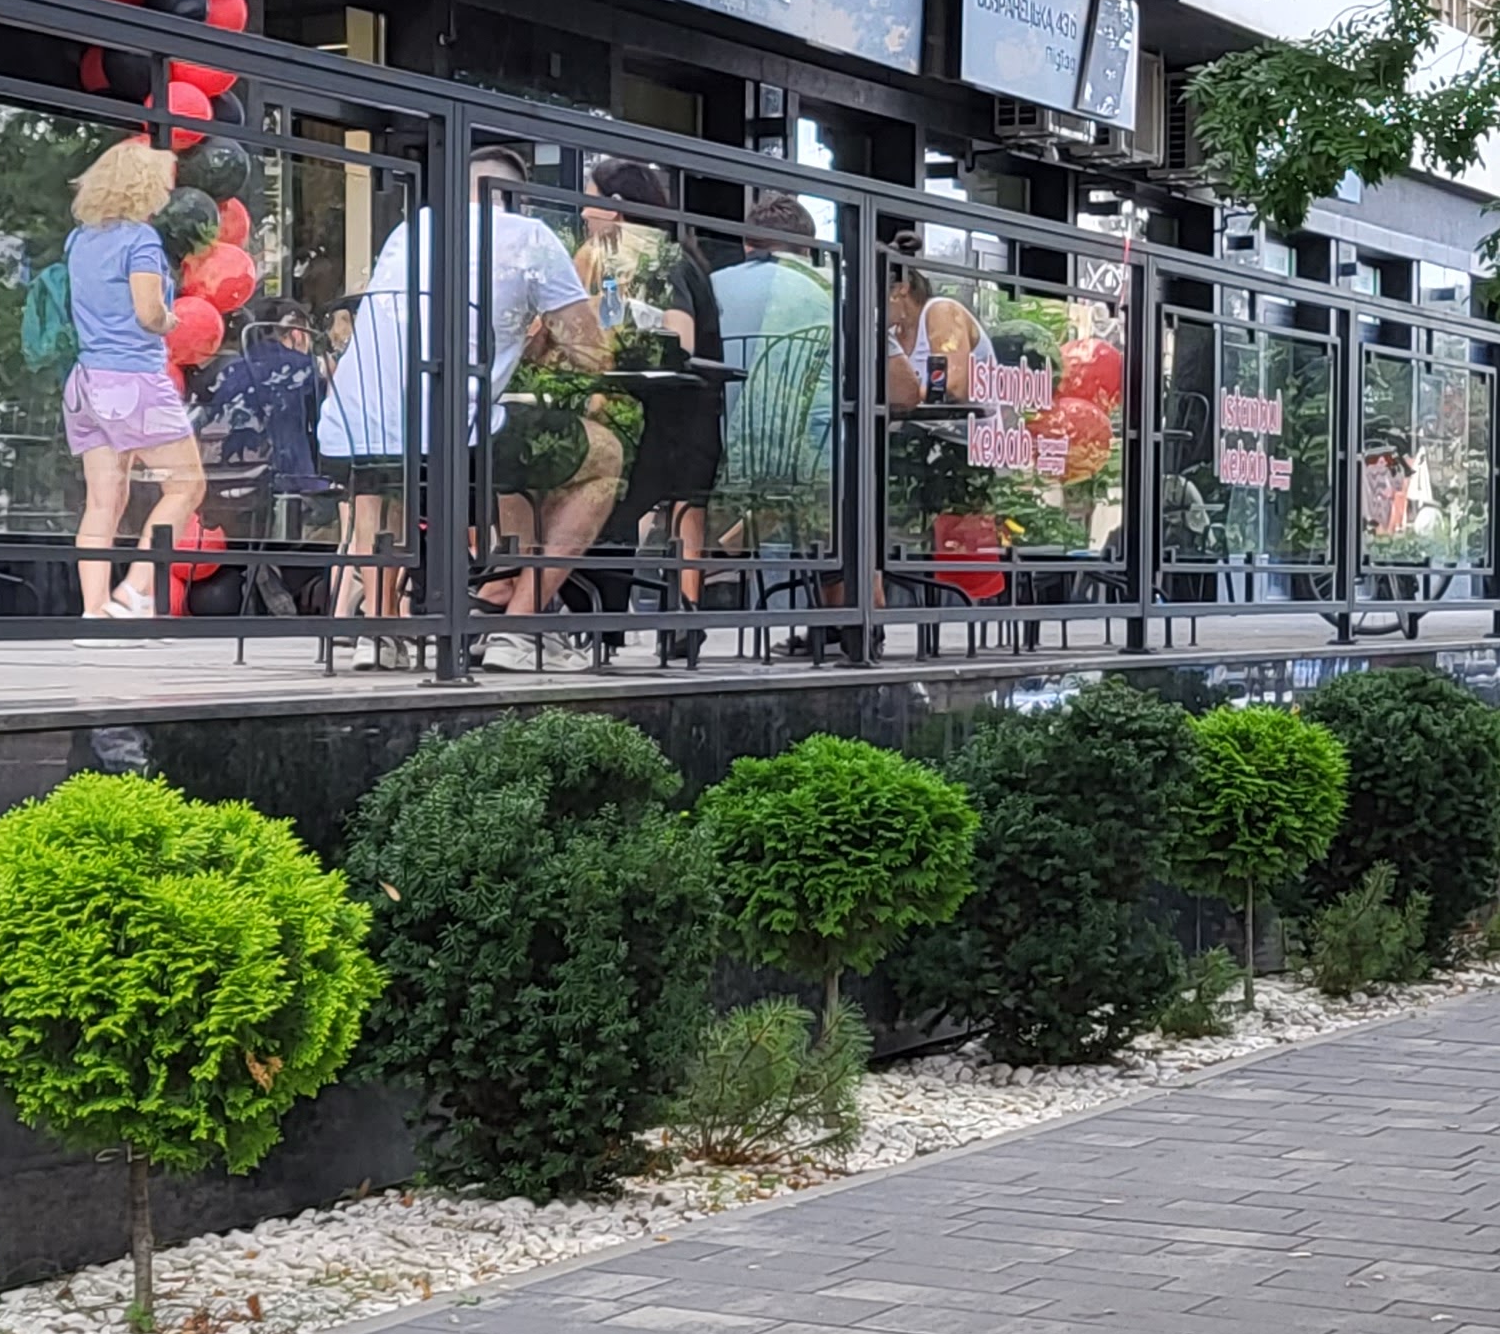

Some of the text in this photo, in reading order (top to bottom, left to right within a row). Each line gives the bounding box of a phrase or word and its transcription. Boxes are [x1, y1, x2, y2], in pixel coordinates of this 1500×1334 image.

[968, 352, 1053, 413] Istanbul
[967, 412, 1032, 469] kebab
[1220, 438, 1267, 486] kebab
